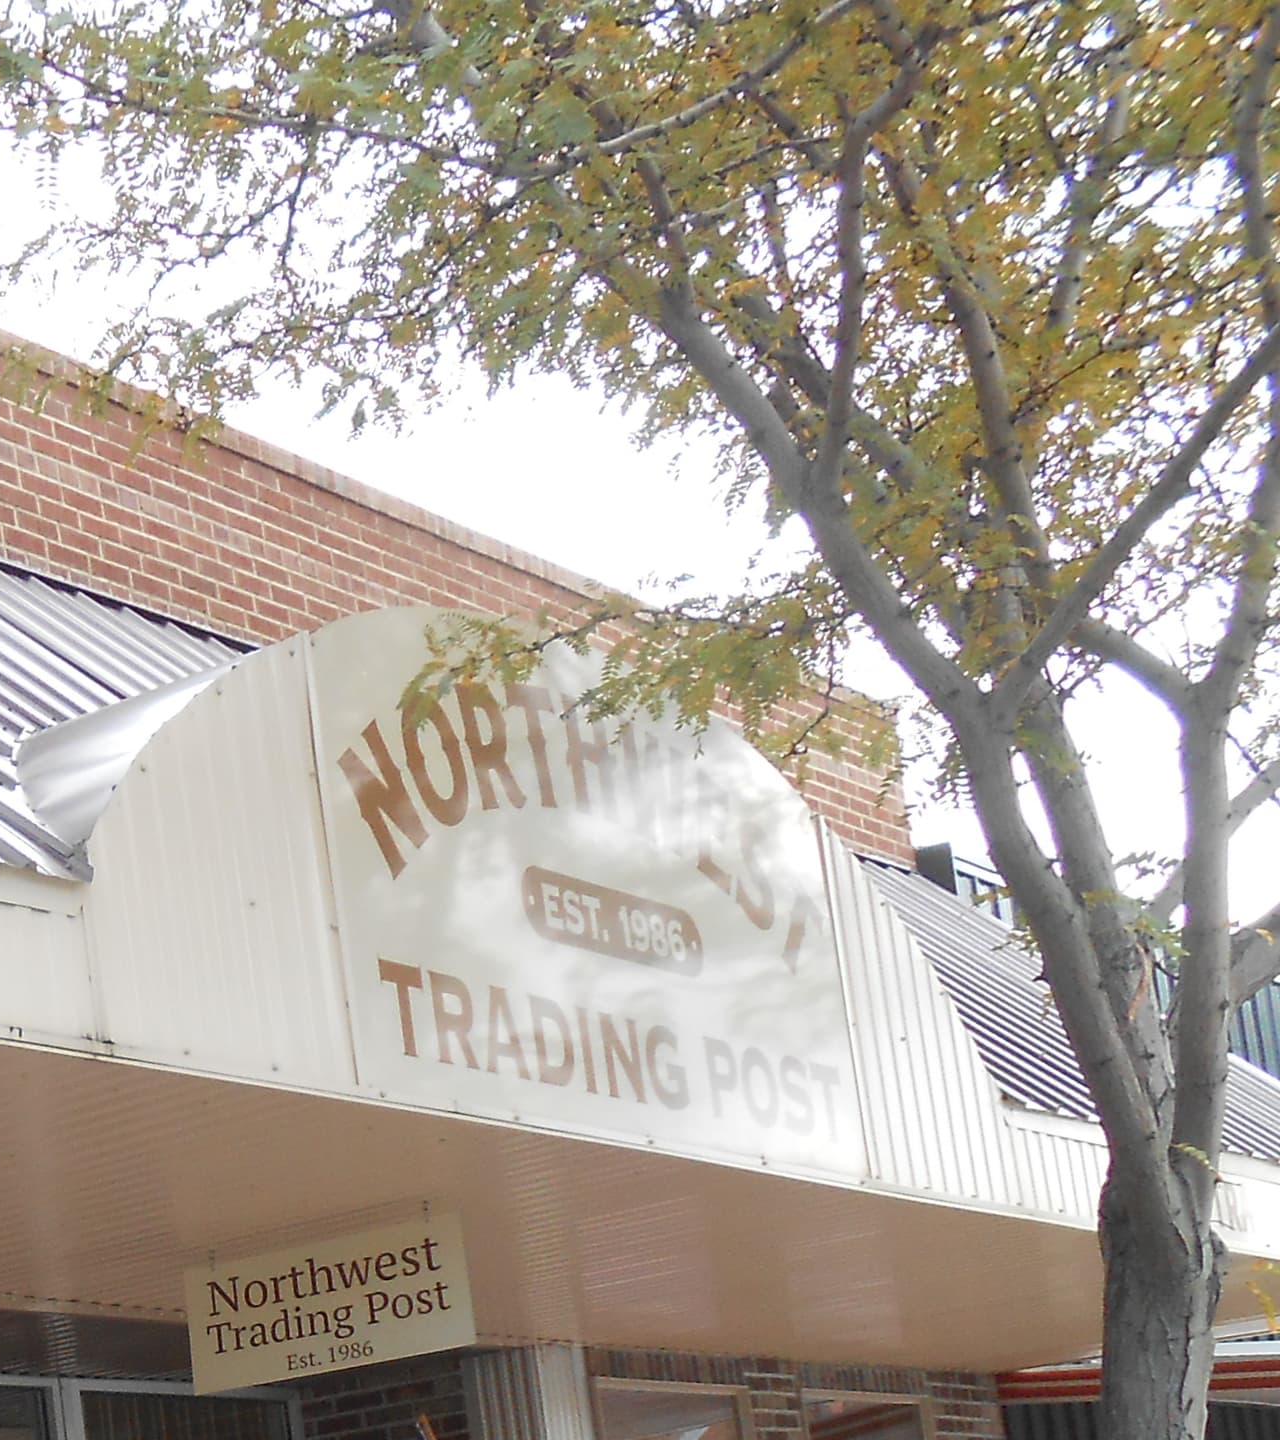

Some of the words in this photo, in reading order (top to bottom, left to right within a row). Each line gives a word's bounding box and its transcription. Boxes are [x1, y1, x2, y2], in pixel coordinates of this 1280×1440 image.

[541, 882, 610, 943] EST.
[618, 905, 688, 962] 1986
[378, 957, 692, 1110] TRADING
[702, 1034, 839, 1143] POST
[206, 1237, 442, 1317] Northwest
[206, 1306, 356, 1354] Trading
[365, 1281, 452, 1325] Post
[287, 1354, 322, 1371] Est.
[328, 1340, 375, 1364] 1986
